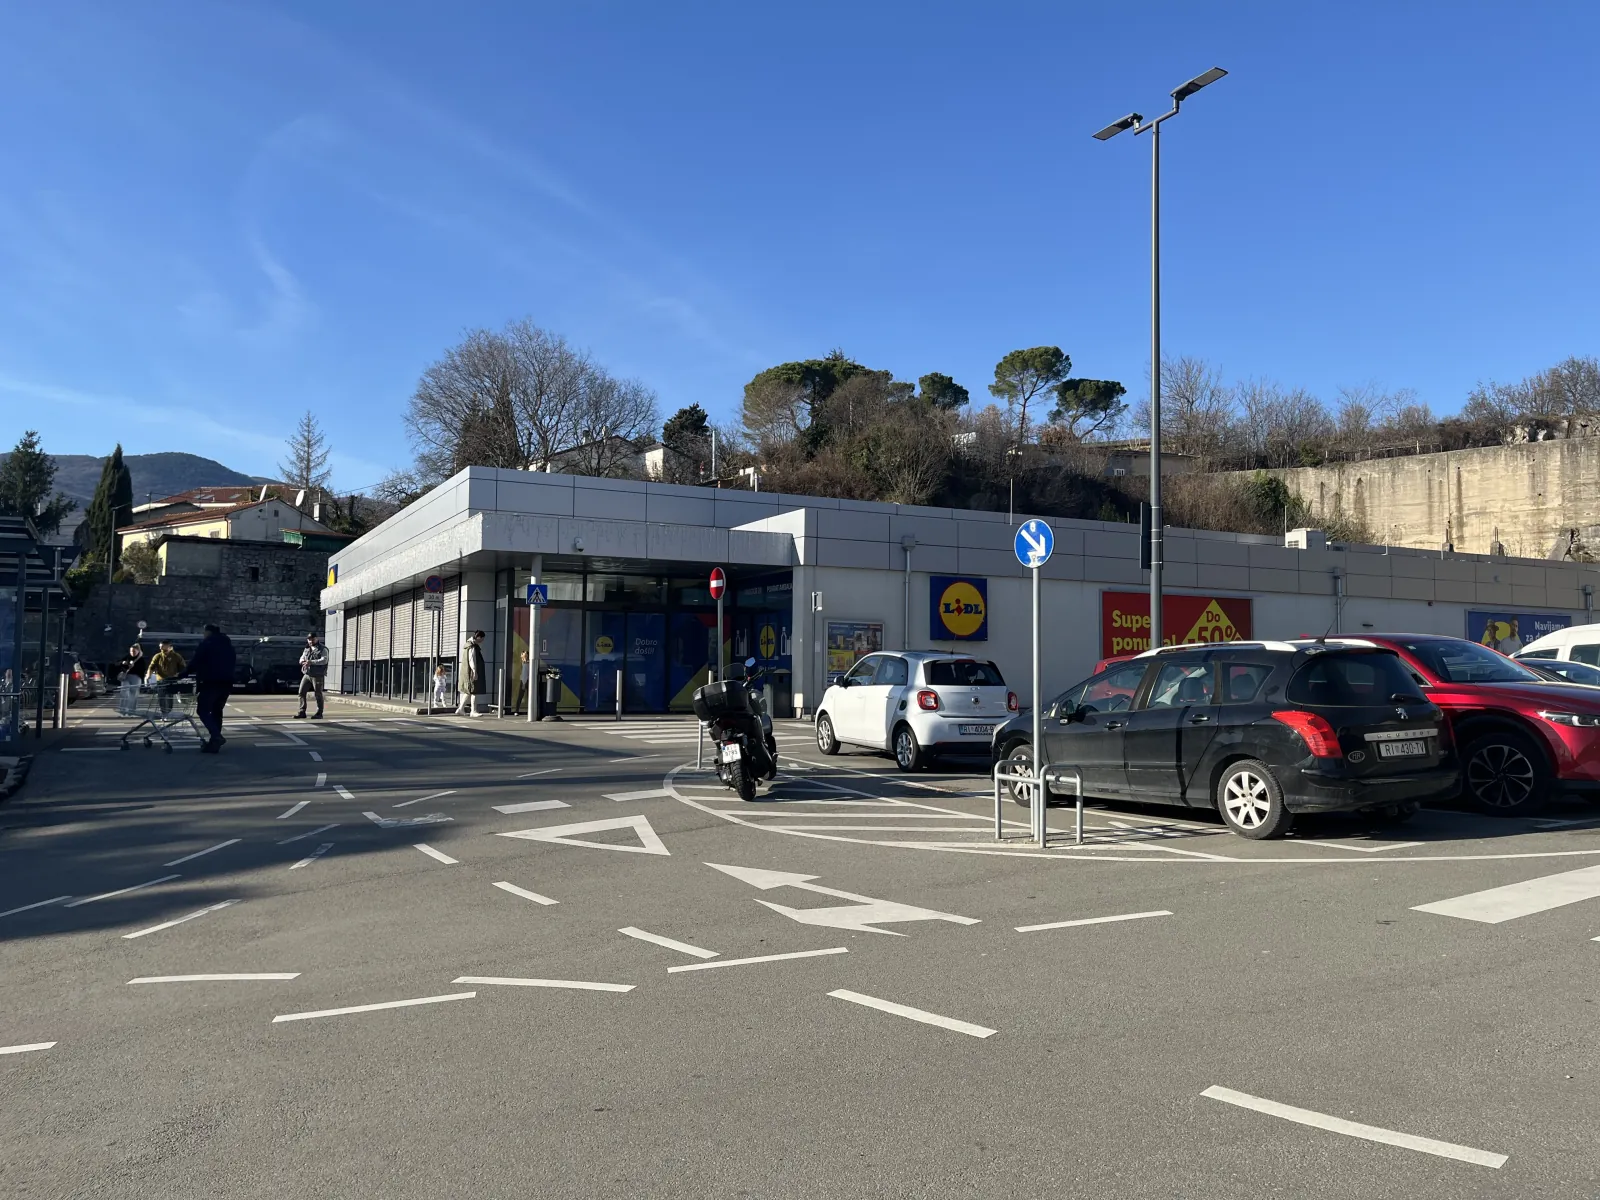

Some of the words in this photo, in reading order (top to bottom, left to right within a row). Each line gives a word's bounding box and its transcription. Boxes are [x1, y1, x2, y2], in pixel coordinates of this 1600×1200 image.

[943, 598, 983, 616] LIDL
[1112, 610, 1151, 634] Supe
[1206, 611, 1221, 625] Do
[1534, 620, 1565, 632] Navijamo
[635, 638, 658, 646] Dobro
[1112, 635, 1176, 654] ponua!
[1525, 634, 1534, 642] za
[1352, 752, 1361, 760] HR
[1385, 744, 1394, 756] RI
[1400, 742, 1425, 755] 430-TV
